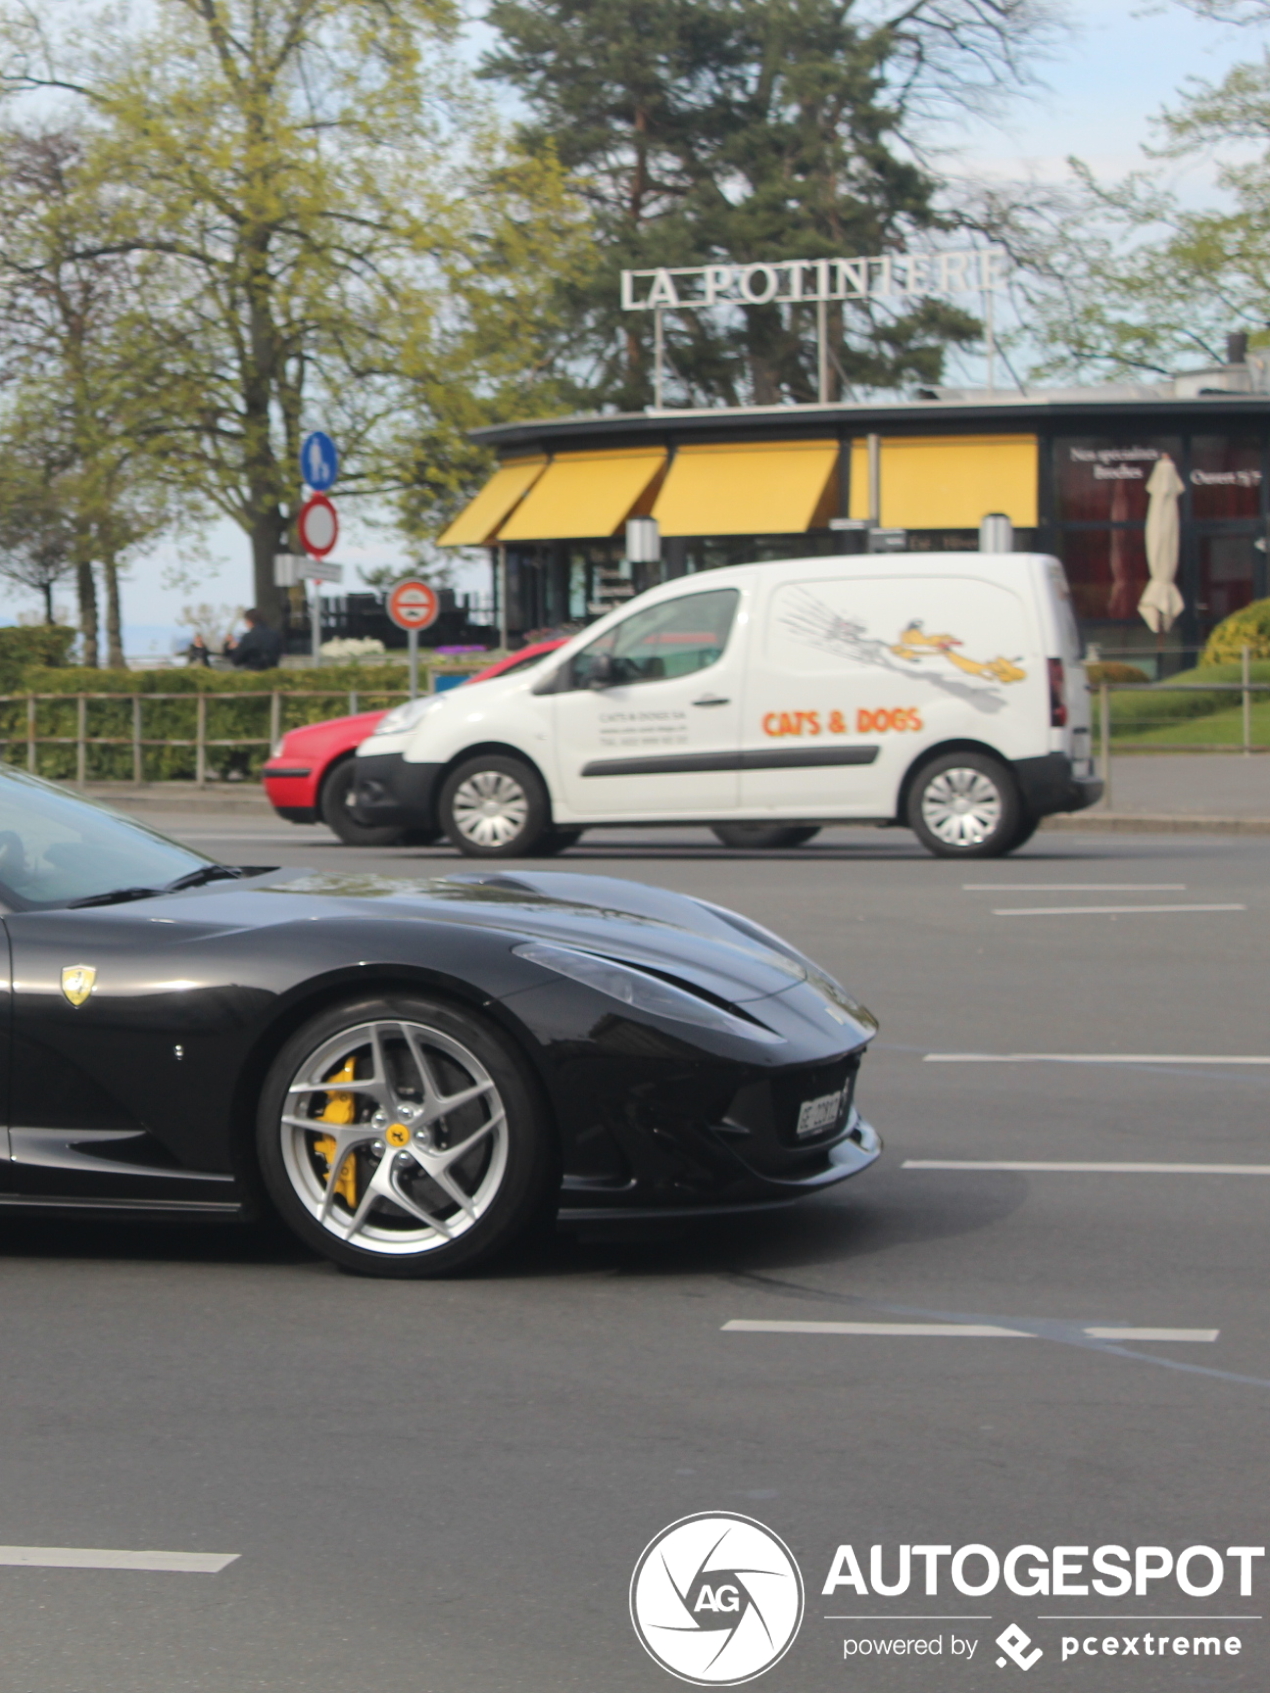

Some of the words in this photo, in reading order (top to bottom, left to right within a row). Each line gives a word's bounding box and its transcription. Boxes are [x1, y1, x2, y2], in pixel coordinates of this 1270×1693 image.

[621, 268, 679, 311] LA
[762, 710, 821, 737] CATS
[829, 710, 847, 734] &
[856, 707, 924, 734] DOGS
